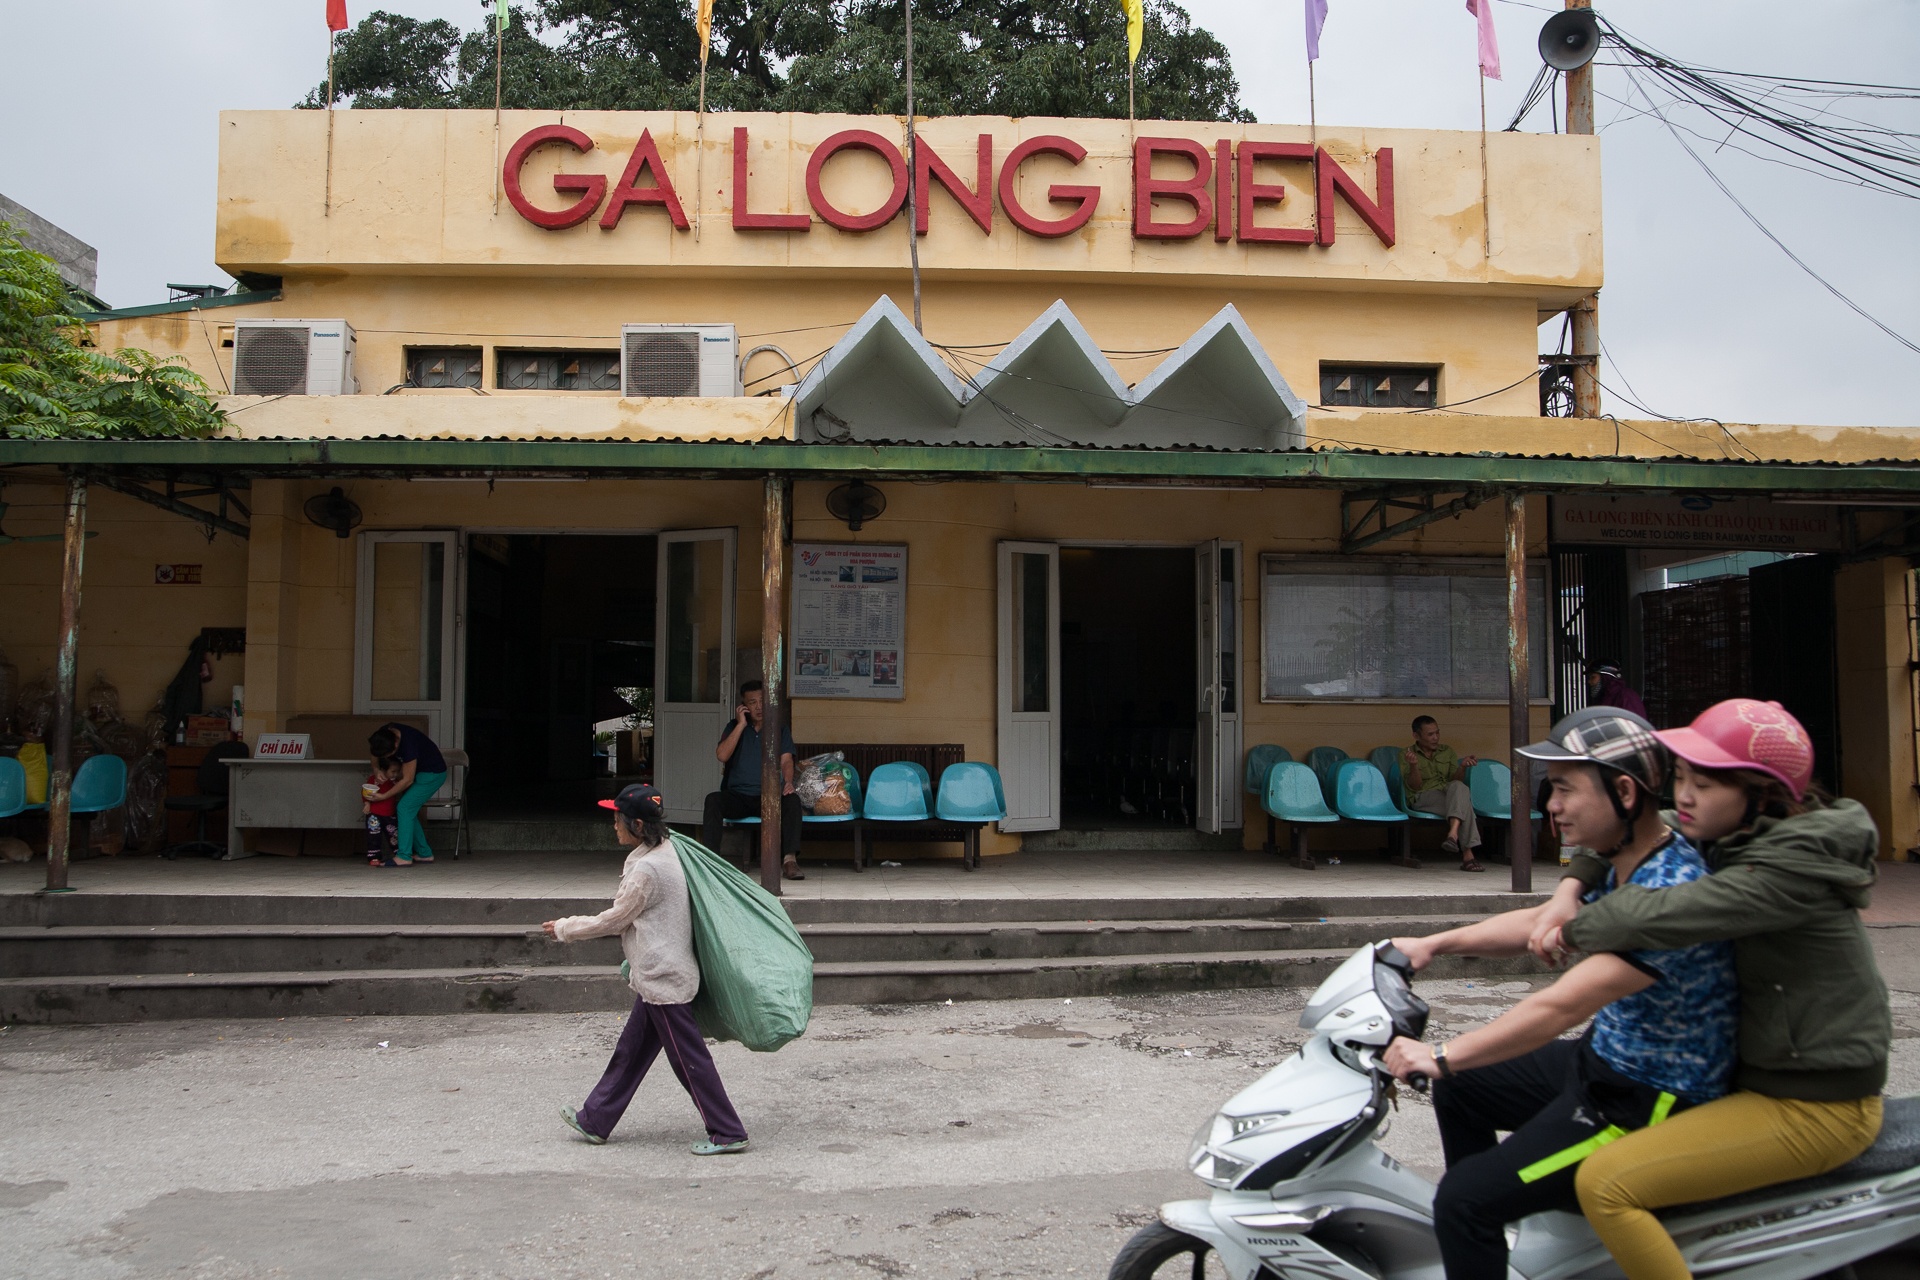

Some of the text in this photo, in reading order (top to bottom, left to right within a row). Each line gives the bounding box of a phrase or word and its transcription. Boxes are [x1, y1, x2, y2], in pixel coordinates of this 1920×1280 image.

[503, 124, 1395, 249] GA LONG BIEN
[1565, 509, 1585, 523] GA
[1589, 510, 1627, 525] LONG
[1631, 509, 1662, 526] BIÊN
[1667, 510, 1700, 527] KÍNH
[1600, 529, 1795, 544] WELCOME TO LONG BIEN RAILWAY STATION
[260, 739, 303, 754] CHỈ DẪN
[1247, 1238, 1299, 1246] HONDA
